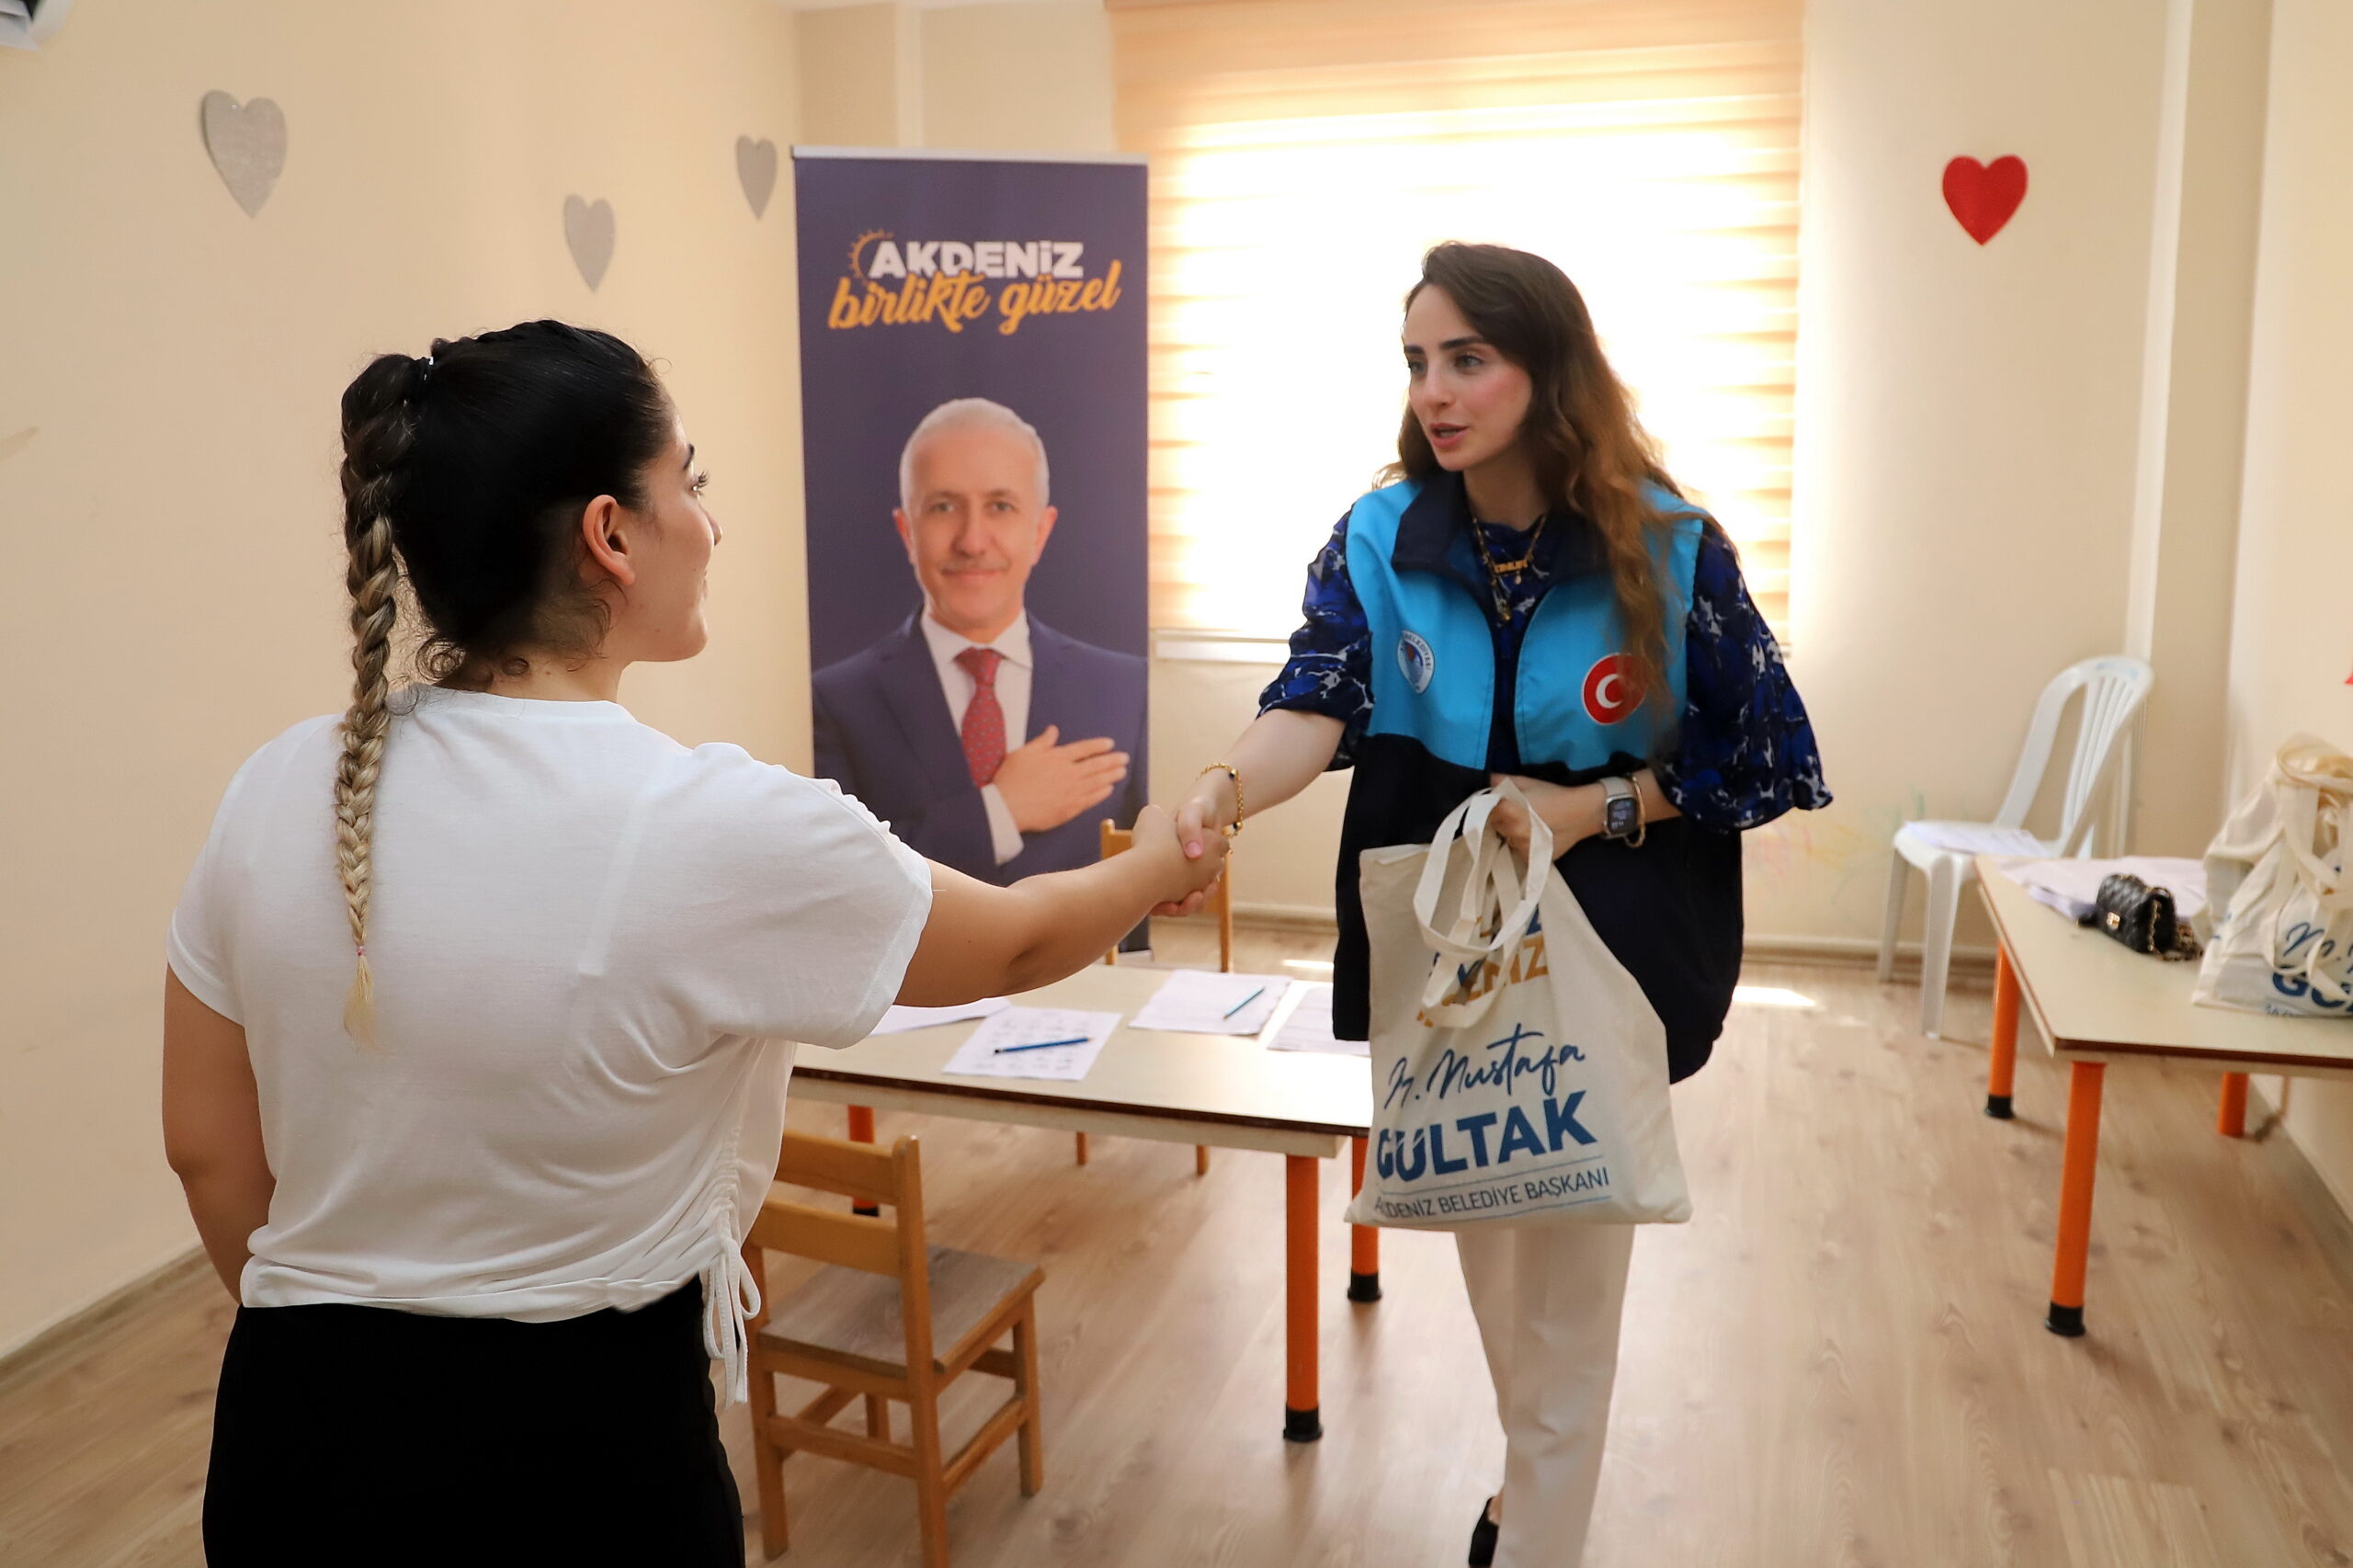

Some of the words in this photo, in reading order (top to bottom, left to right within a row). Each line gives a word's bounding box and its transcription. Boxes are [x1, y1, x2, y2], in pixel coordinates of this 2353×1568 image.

[828, 267, 992, 333] birlikte
[999, 259, 1122, 335] güzel
[869, 240, 1085, 278] AKDENİZ
[1427, 1023, 1586, 1099] Mustafa
[1377, 1090, 1597, 1182] GÜLTAK
[1375, 1195, 1436, 1218] ADENİZ
[1438, 1185, 1522, 1214] BELEDİYE
[1524, 1167, 1609, 1200] BAŞKANI
